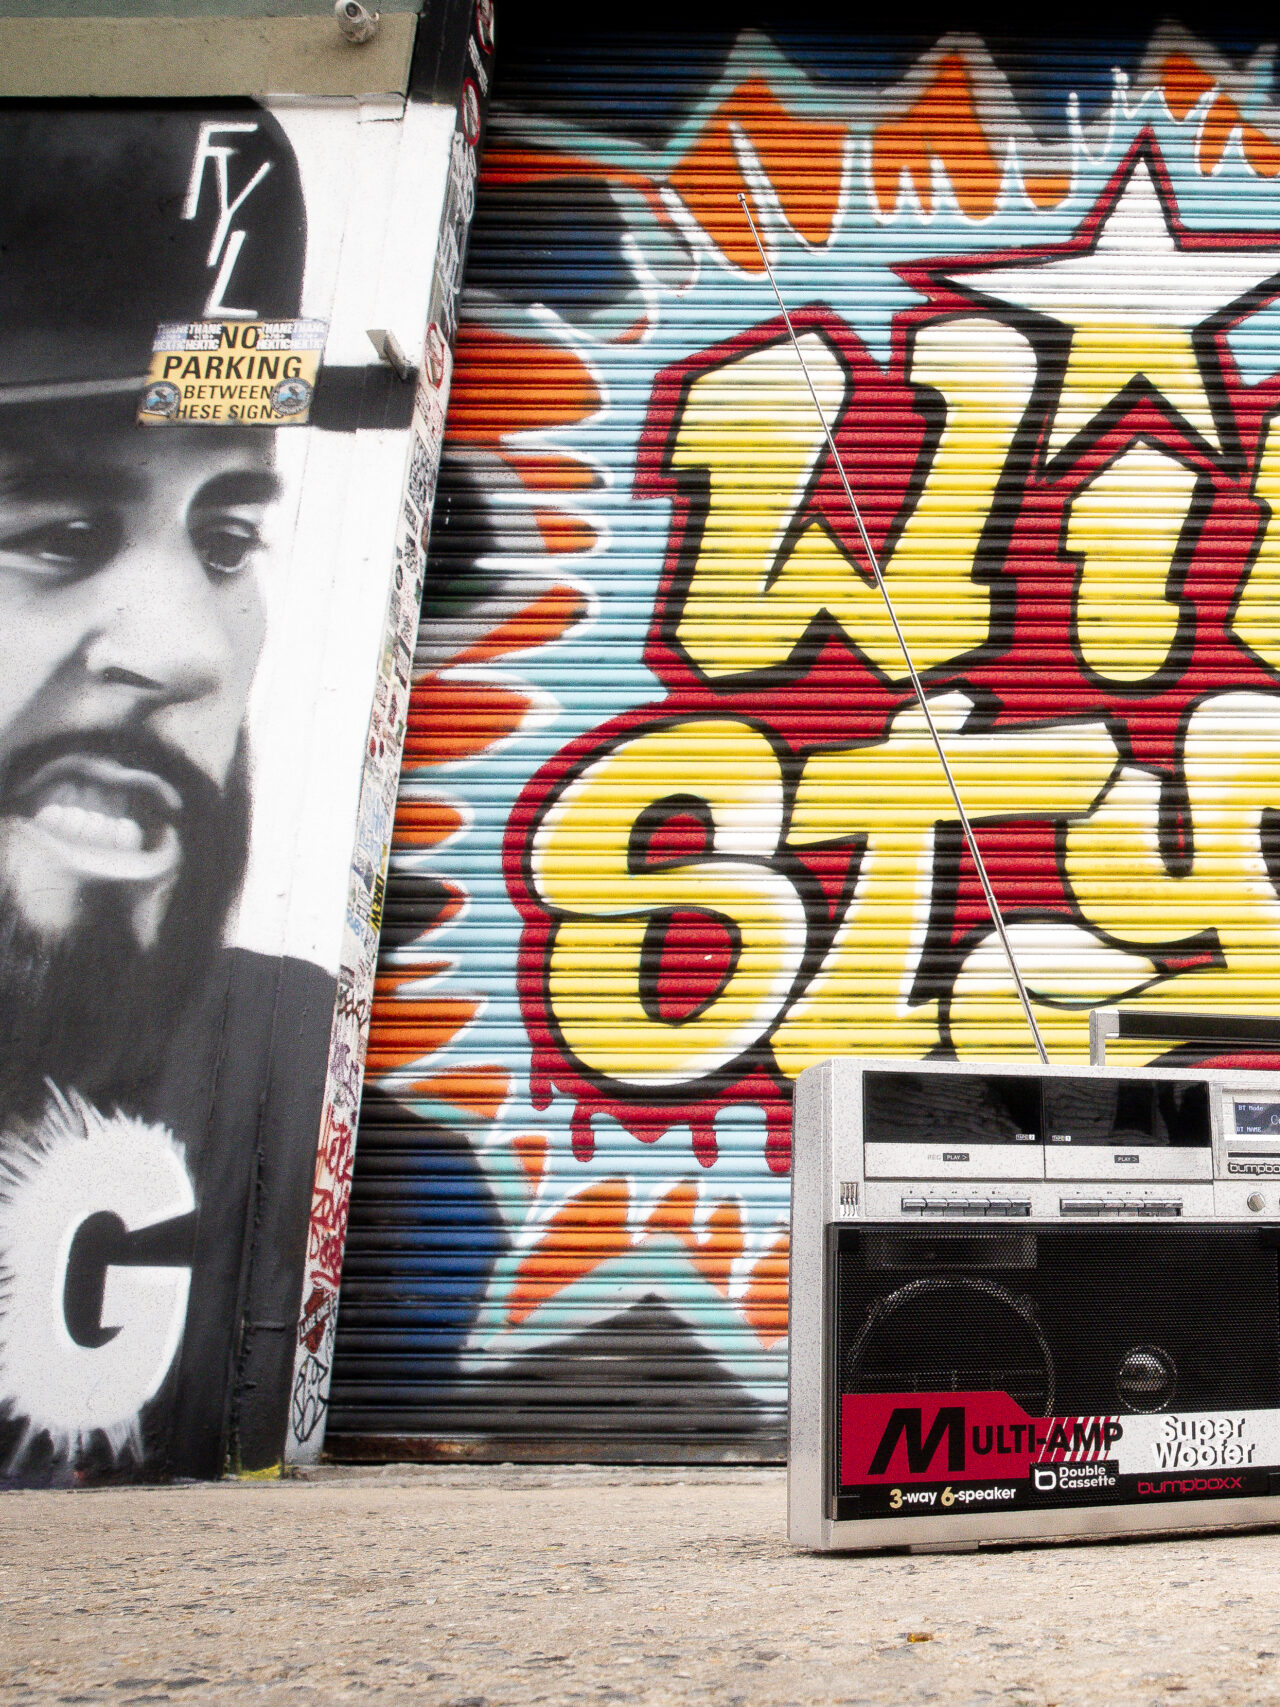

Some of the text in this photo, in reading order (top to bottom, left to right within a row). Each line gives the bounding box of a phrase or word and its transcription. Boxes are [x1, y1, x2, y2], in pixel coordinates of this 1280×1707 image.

[219, 325, 260, 349] NO
[163, 356, 302, 380] PARKING
[184, 385, 274, 400] BETWEEN
[174, 404, 222, 419] HESE
[867, 1407, 1124, 1475] MULTI-AMP
[1160, 1414, 1246, 1446] Super
[1153, 1439, 1256, 1469] Woofer
[1059, 1465, 1106, 1479] Double
[1059, 1475, 1116, 1489] Cassette
[1137, 1476, 1243, 1495] bumpboxx
[889, 1486, 1017, 1509] 3-way 6-speaker
